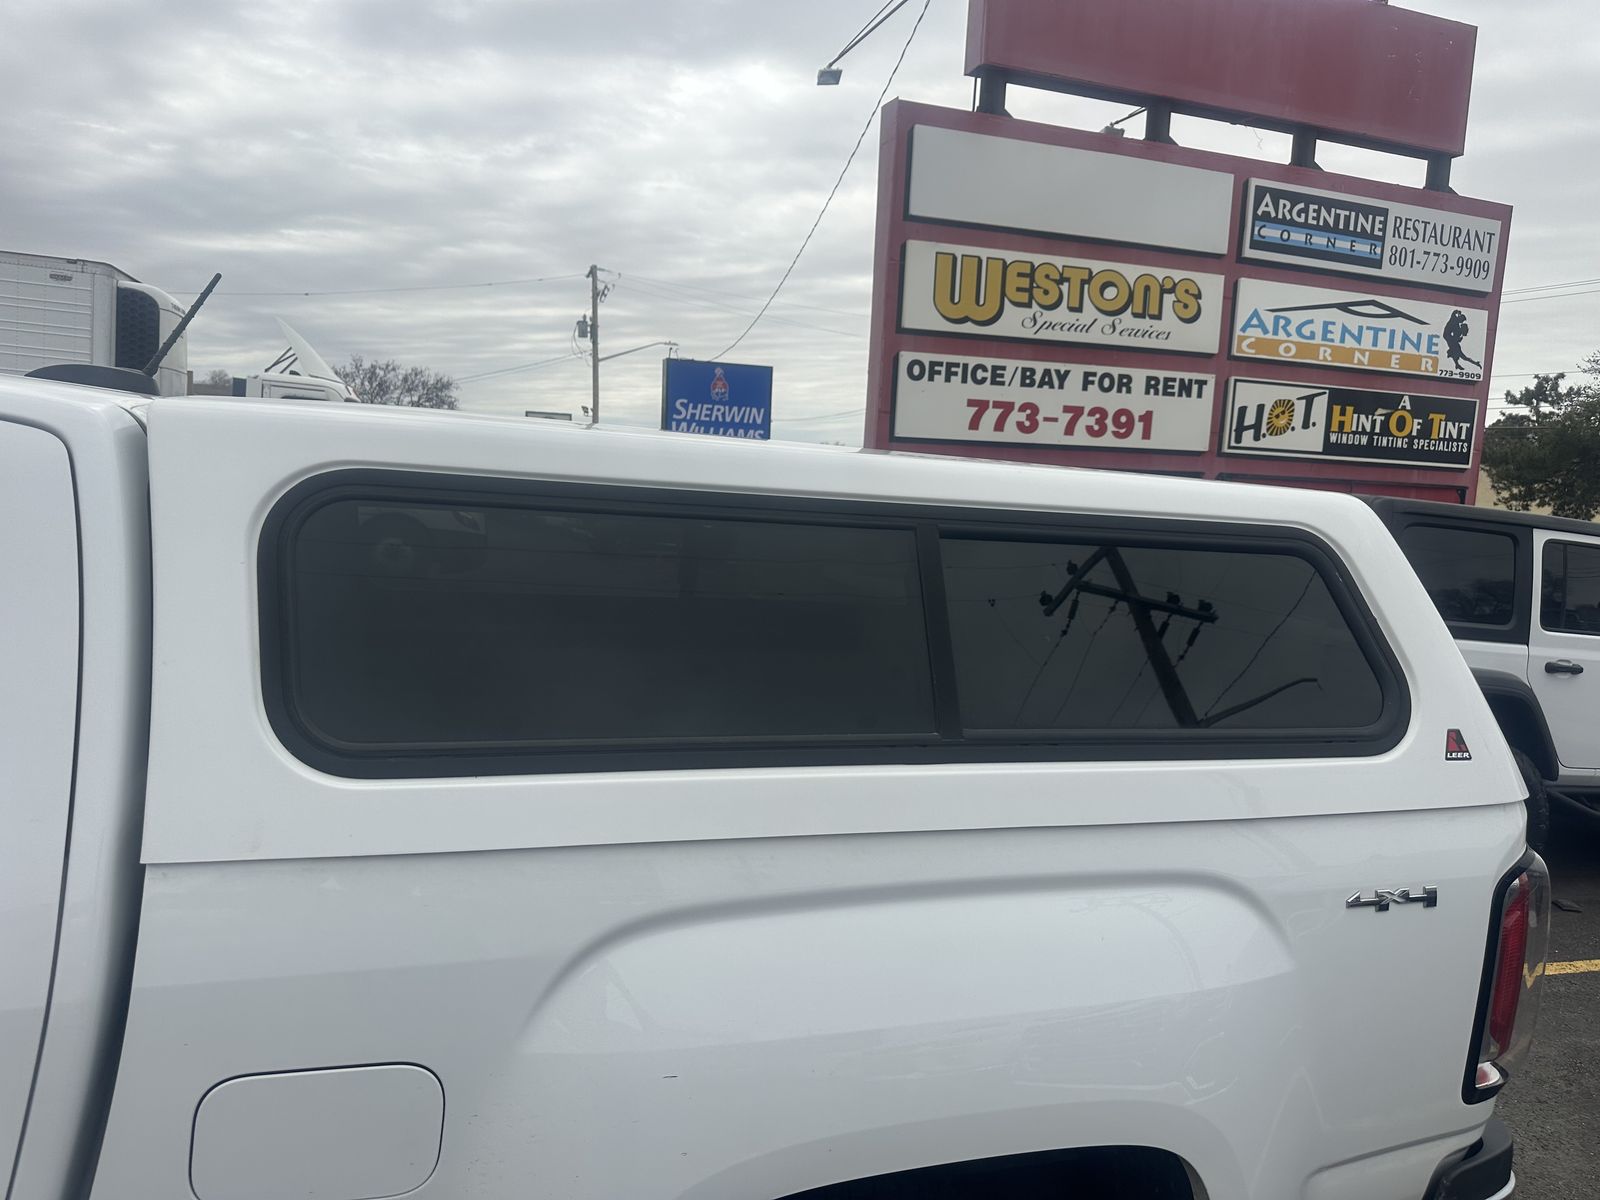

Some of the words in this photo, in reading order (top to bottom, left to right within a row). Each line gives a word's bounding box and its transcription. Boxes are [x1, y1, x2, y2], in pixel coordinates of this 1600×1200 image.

[1256, 192, 1385, 237] ARGENTINE
[1257, 224, 1379, 256] CORNER
[1392, 215, 1496, 254] RESTAURANT
[1388, 245, 1491, 281] 801-773-9909
[933, 251, 1202, 326] WESTON'S
[1021, 310, 1098, 335] Special
[1100, 317, 1172, 341] Services
[1239, 307, 1441, 355] ARGENTINE
[1240, 337, 1434, 372] CORNER
[906, 359, 1071, 391] OFFICE/BAY
[1082, 370, 1132, 395] FOR
[1144, 375, 1208, 399] RENT
[1438, 369, 1483, 380] 773-9909
[672, 398, 765, 425] SHERWIN
[965, 398, 1154, 441] 773-7391
[1398, 395, 1412, 410] A
[1329, 404, 1386, 434] HINT
[1388, 409, 1423, 438] OF
[1427, 412, 1471, 441] TINT
[1329, 432, 1369, 446] WINDOW
[1372, 435, 1409, 449] TINTING
[1412, 438, 1469, 454] SPECIALISTS
[1447, 751, 1470, 759] LEER
